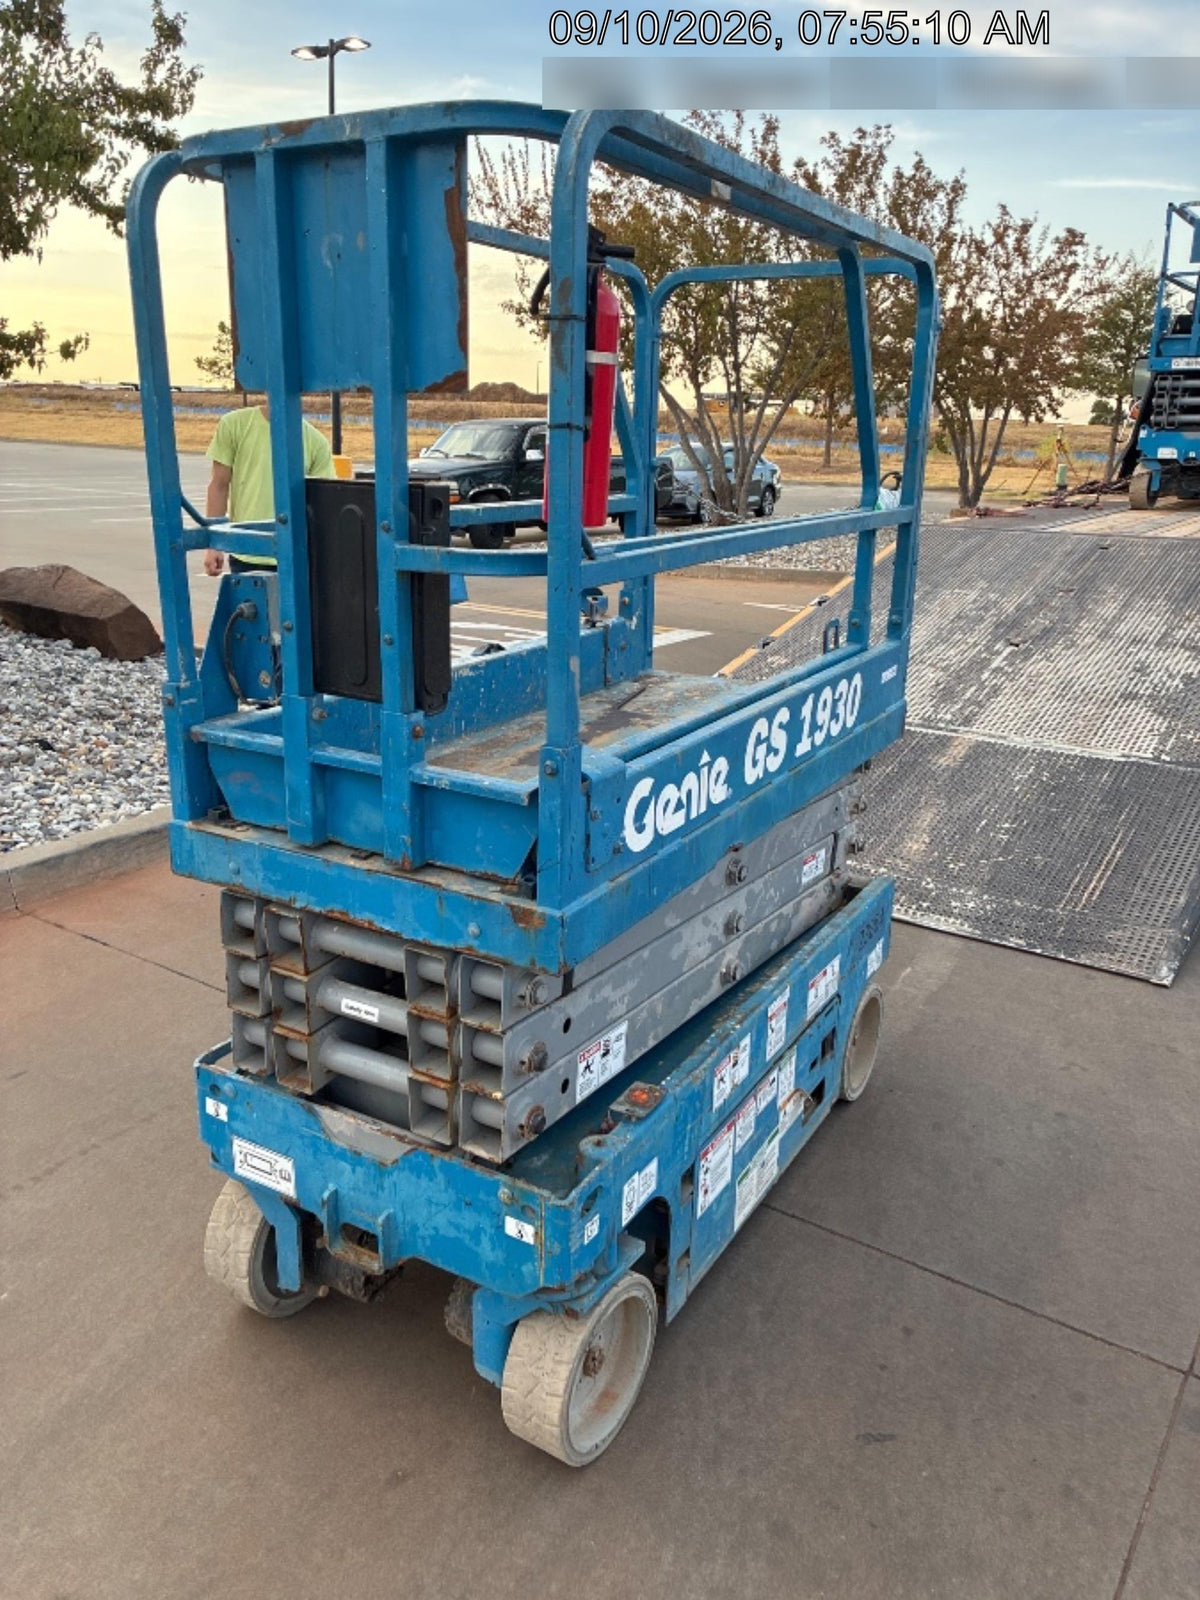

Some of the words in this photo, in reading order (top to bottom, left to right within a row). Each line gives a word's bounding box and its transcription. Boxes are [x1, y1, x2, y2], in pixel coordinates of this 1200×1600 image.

[623, 750, 731, 853] Genie
[744, 706, 790, 785] GS
[794, 672, 863, 758] 1930
